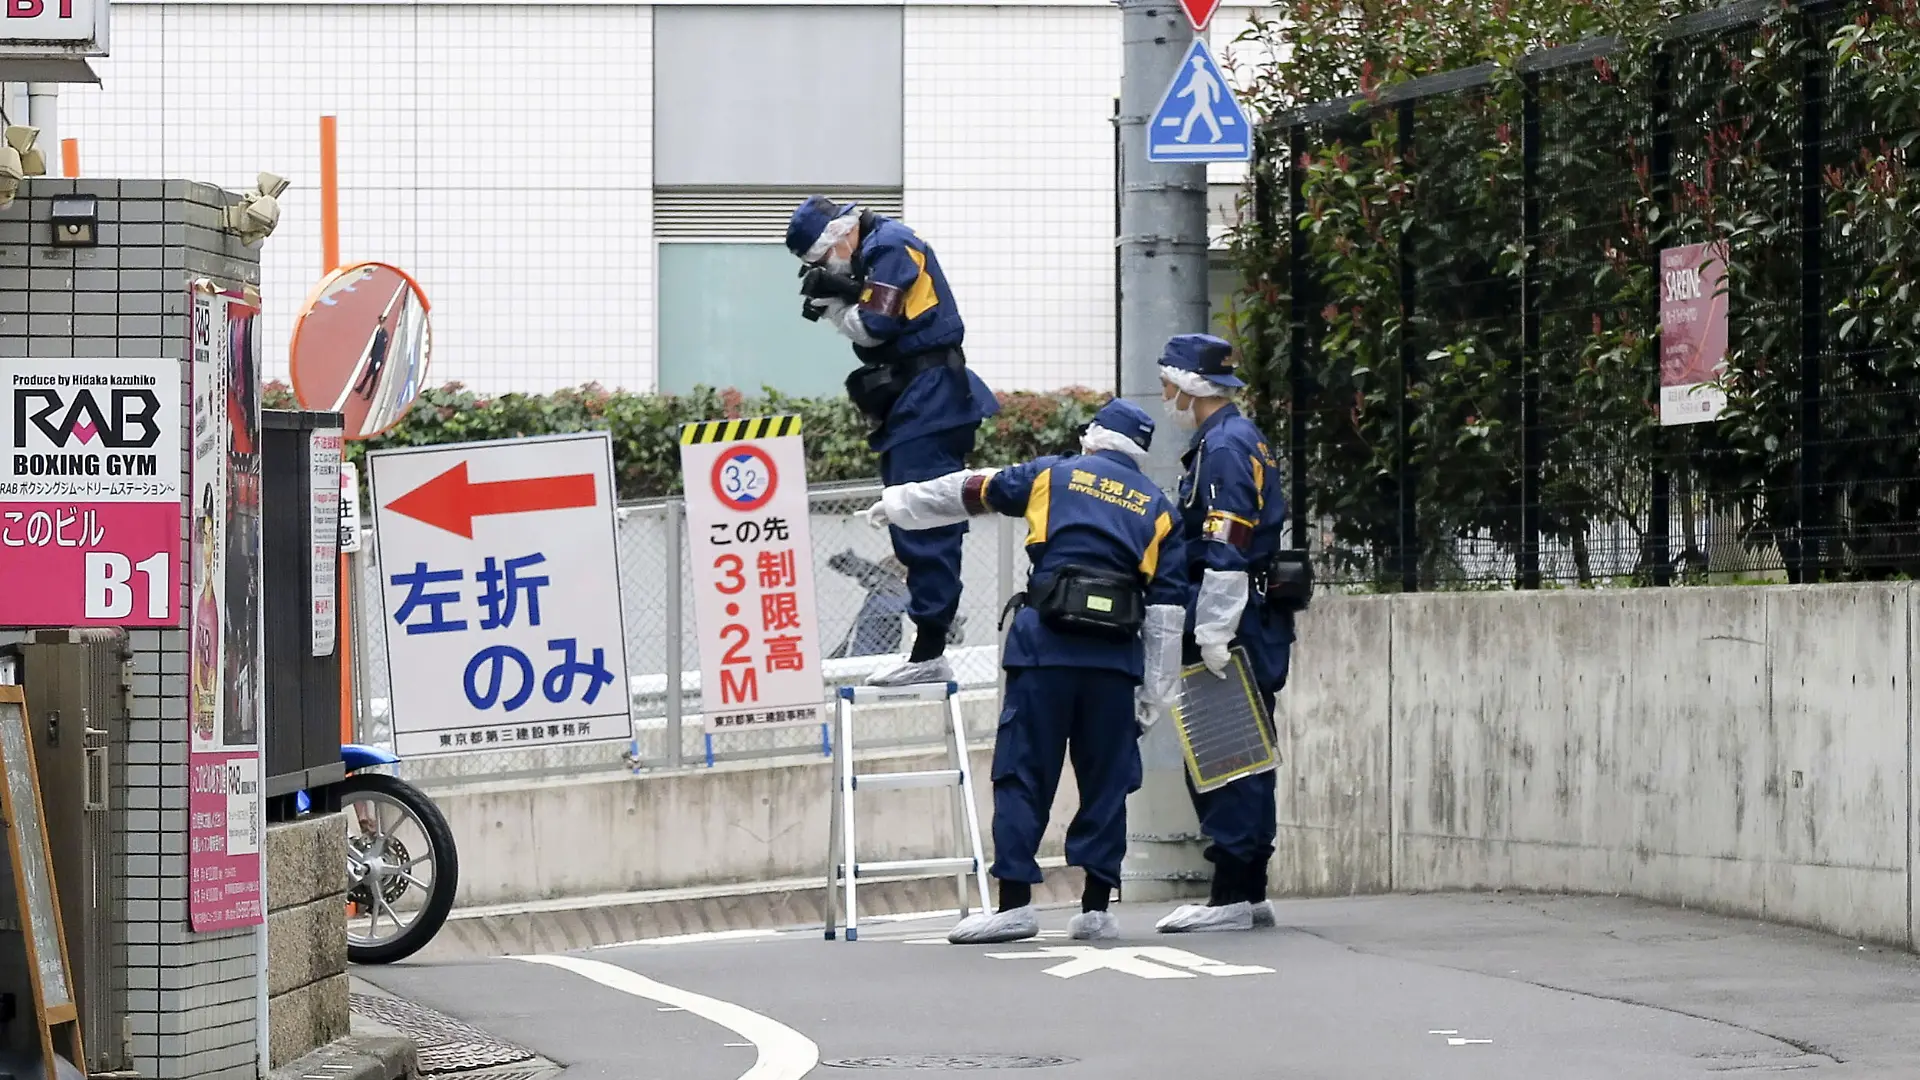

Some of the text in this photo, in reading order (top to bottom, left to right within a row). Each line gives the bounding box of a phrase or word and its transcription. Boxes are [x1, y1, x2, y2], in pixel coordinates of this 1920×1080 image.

[13, 375, 156, 386] Produce by Hidaka kazuhiko
[14, 389, 161, 448] RAB
[13, 454, 157, 476] BOXING GYM
[0, 483, 18, 495] RAB
[1068, 483, 1147, 516] INVESTIGATION
[2, 506, 105, 547] このビル
[710, 517, 789, 545] この先
[85, 552, 169, 619] B1
[390, 552, 549, 635] 左折
[756, 549, 804, 673] 制限高
[463, 638, 615, 712] のみ
[439, 721, 591, 747] 東京都第三建設事務所
